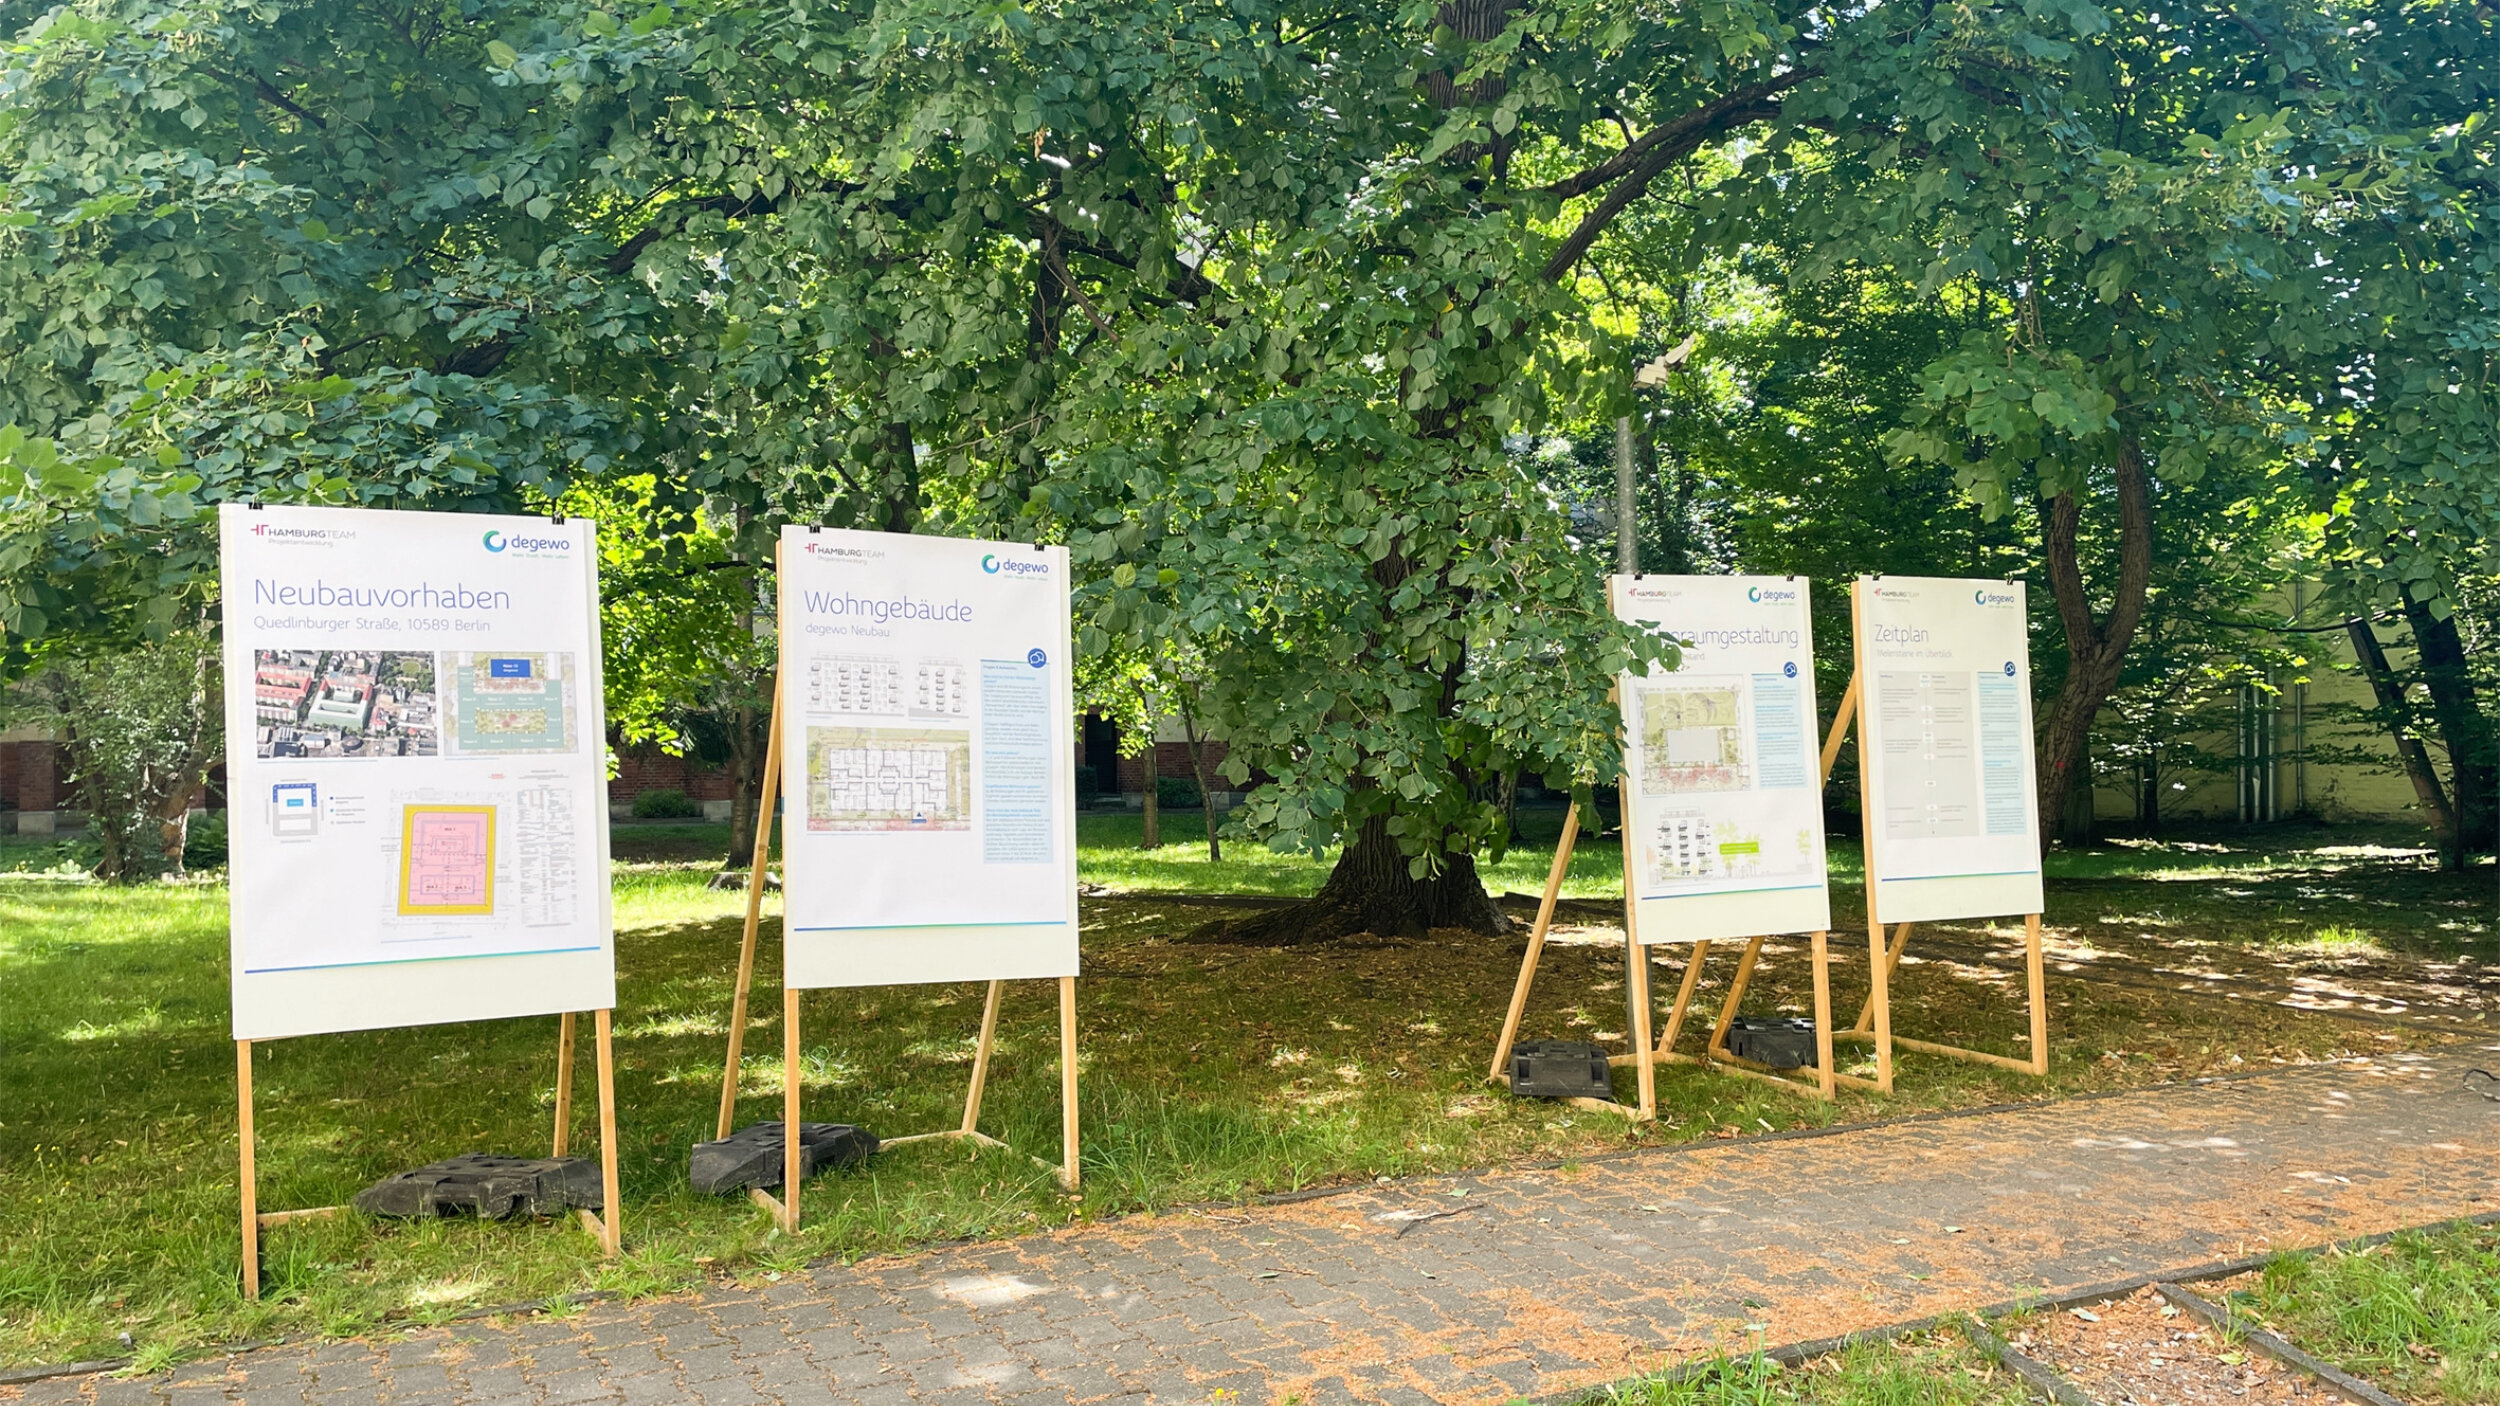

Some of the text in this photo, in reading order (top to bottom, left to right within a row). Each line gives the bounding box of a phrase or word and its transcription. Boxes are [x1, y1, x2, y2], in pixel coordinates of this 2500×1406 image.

[511, 534, 570, 552] degewo
[1003, 558, 1048, 575] degewo
[255, 578, 509, 609] Neubauvorhaben
[1763, 588, 1795, 602] degewo
[1988, 592, 2015, 605] degewo
[804, 590, 972, 624] Wohngebäude
[253, 615, 490, 632] Quedlinburger Straße, 10589 Berlin
[805, 623, 890, 637] degewo Neubau
[1875, 624, 1929, 647] Zeitplan
